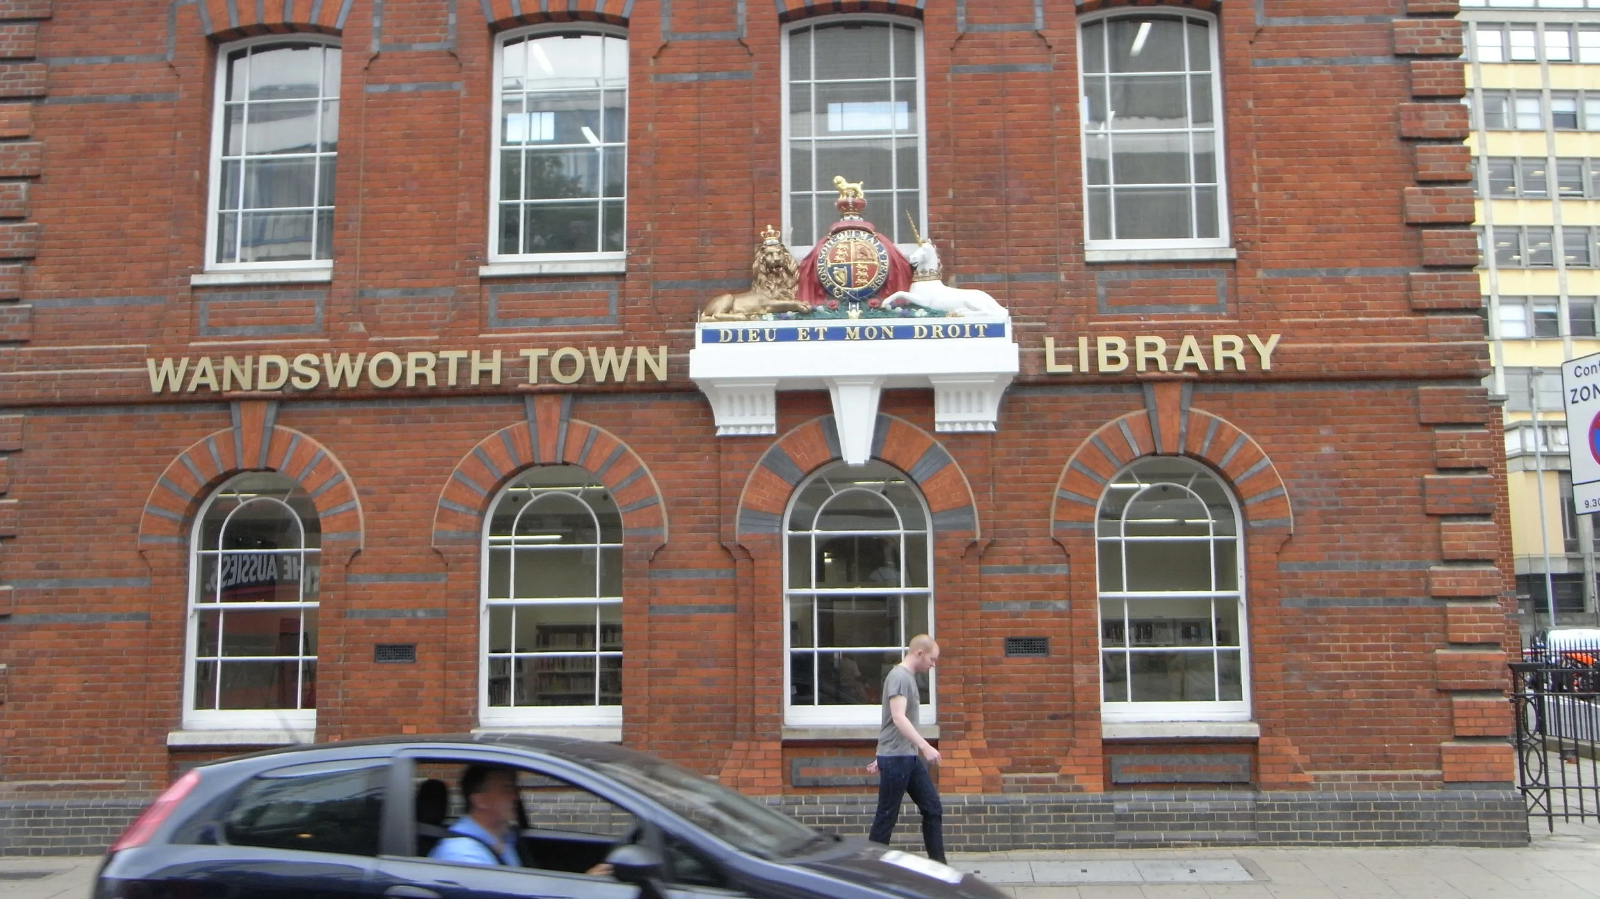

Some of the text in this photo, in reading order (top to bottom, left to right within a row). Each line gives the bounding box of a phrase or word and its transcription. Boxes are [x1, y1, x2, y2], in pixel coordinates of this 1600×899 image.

[719, 323, 988, 342] DIEU ET MON DROIT
[147, 334, 1281, 393] WANDSWORTH TOWN LIBRARY
[1574, 360, 1600, 378] Con
